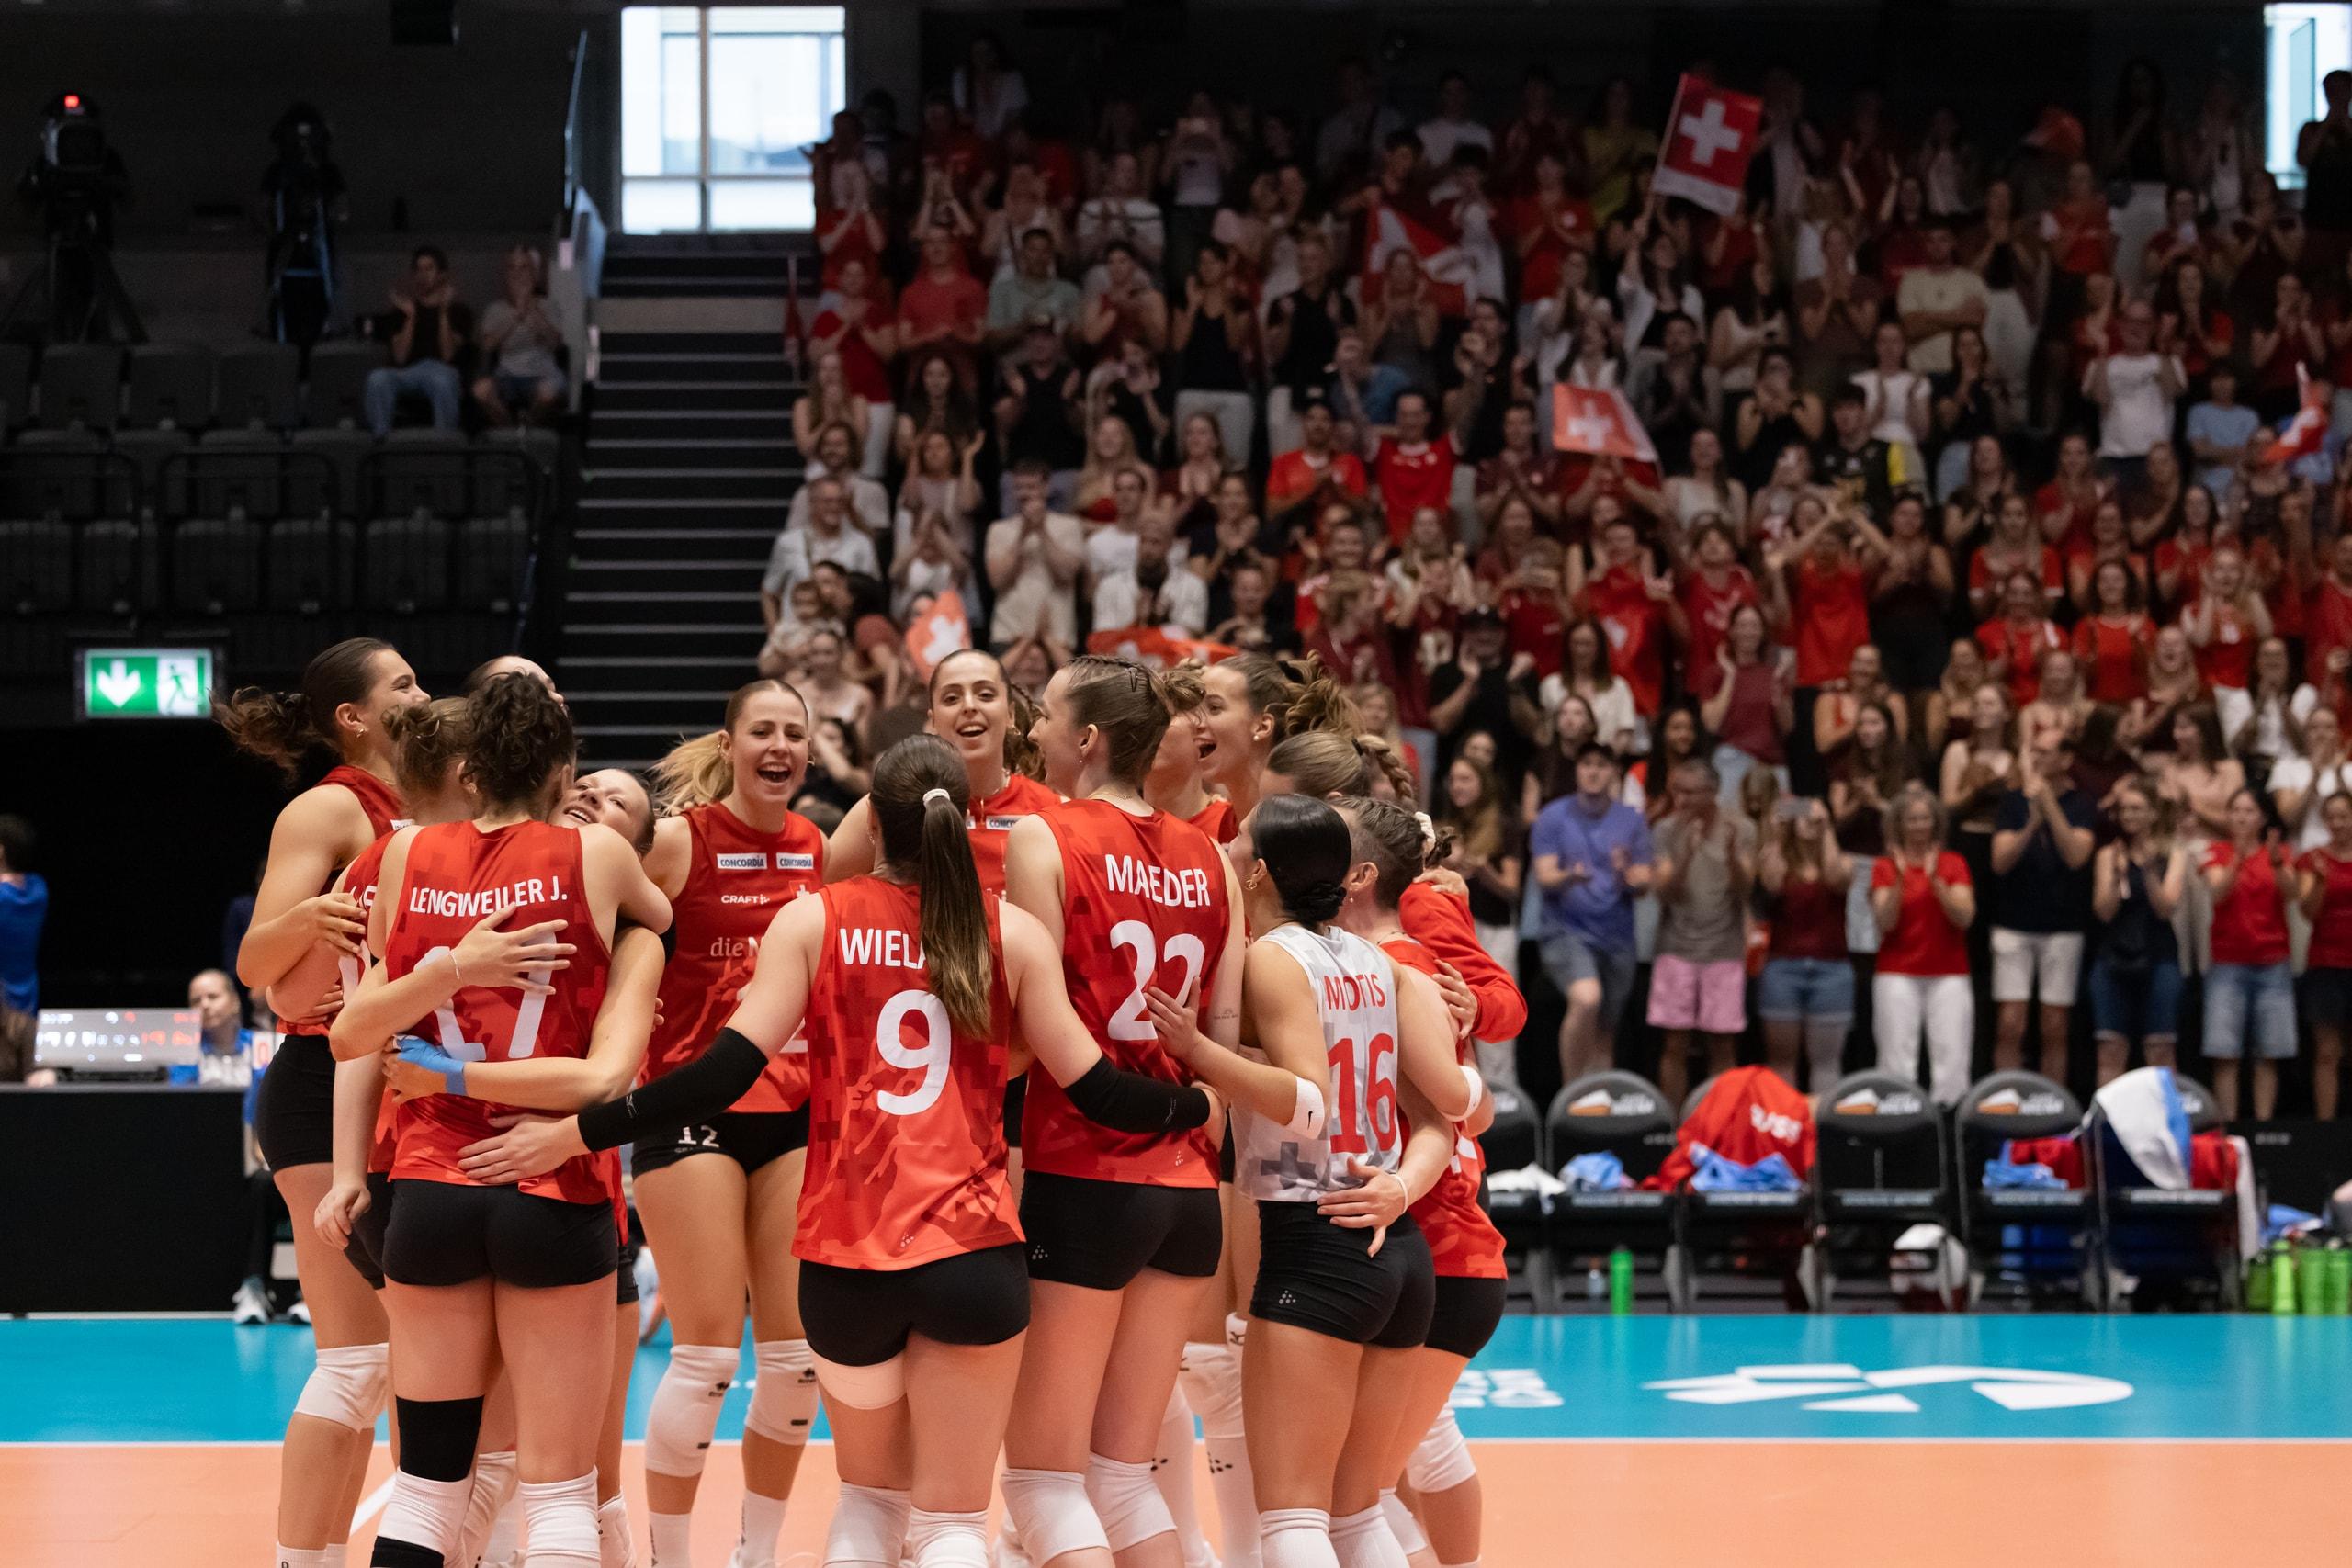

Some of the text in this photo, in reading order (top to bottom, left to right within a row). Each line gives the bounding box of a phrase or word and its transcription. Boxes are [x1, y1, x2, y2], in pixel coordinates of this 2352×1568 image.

[410, 879, 545, 918] LENGWEILER
[550, 875, 568, 901] J.
[721, 895, 759, 904] CRAFT
[1105, 854, 1210, 907] MAEDER
[876, 989, 952, 1115] 9
[1328, 1032, 1397, 1154] 16
[678, 1124, 719, 1148] 12
